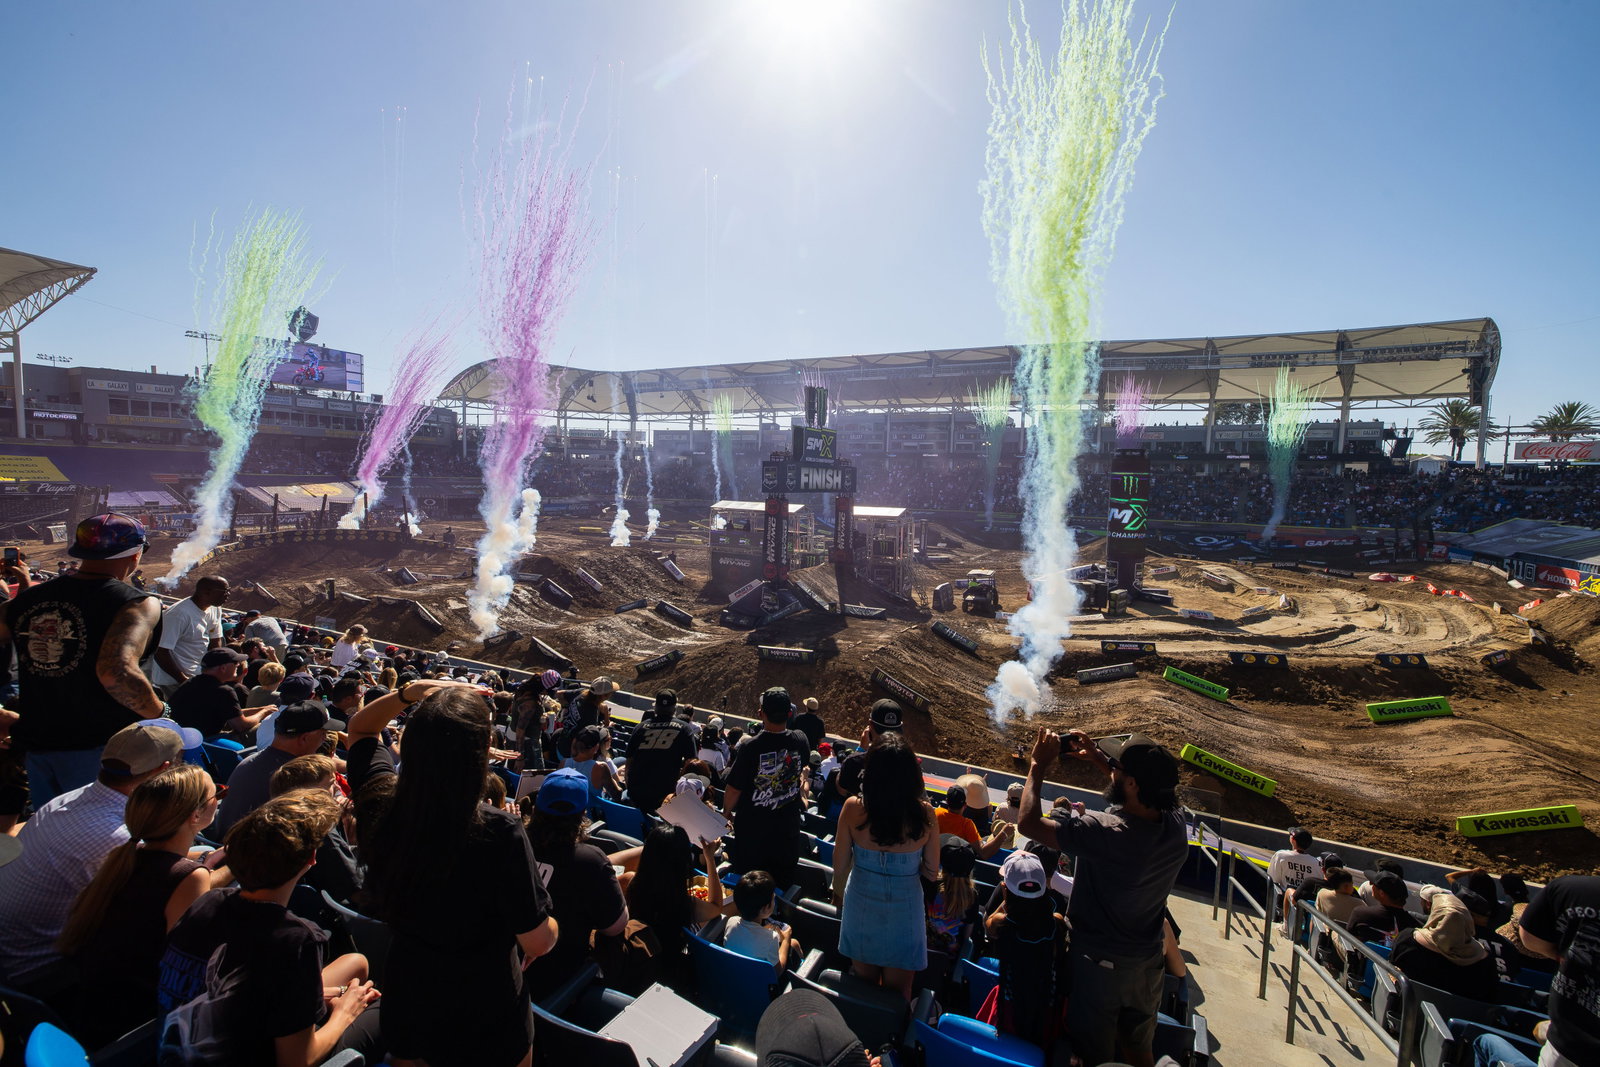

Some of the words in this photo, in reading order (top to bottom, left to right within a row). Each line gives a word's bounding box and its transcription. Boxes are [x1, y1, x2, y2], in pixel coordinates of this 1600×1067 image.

[107, 382, 128, 390] GALAXY
[33, 411, 77, 420] MOTOCROSS
[806, 434, 833, 458] SMX
[800, 466, 842, 490] FINISH
[1547, 574, 1578, 587] HONDA
[885, 677, 915, 700] MONSTER
[1172, 670, 1222, 696] Kawasaki
[1377, 702, 1442, 716] Kawasaki
[638, 728, 681, 750] 38
[1193, 751, 1267, 791] Kawasaki
[1473, 811, 1571, 832] Kawasaki
[1287, 861, 1313, 874] DEUS
[1296, 871, 1305, 880] EX
[1285, 875, 1303, 886] MAC
